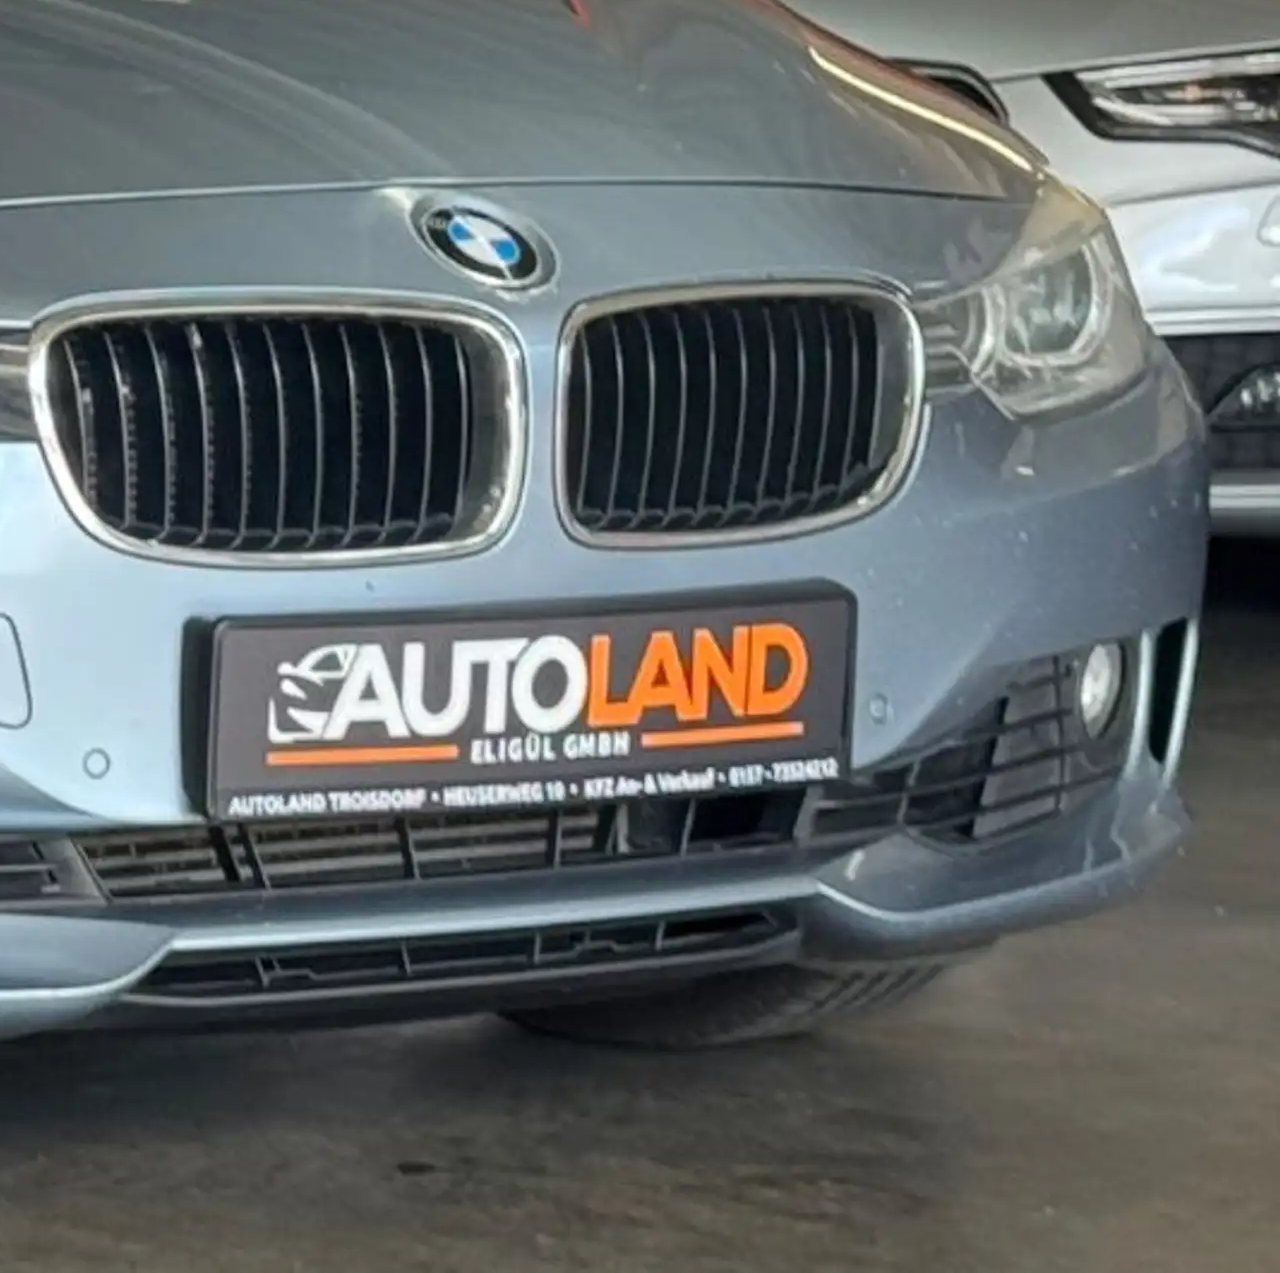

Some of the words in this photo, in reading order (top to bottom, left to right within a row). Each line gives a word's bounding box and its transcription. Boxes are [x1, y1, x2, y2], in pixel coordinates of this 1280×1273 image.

[320, 623, 809, 741] AUTOLAND
[469, 731, 557, 765] ELIGÜL
[228, 791, 328, 817] AUTOLAND
[329, 788, 425, 812] TROISDORF
